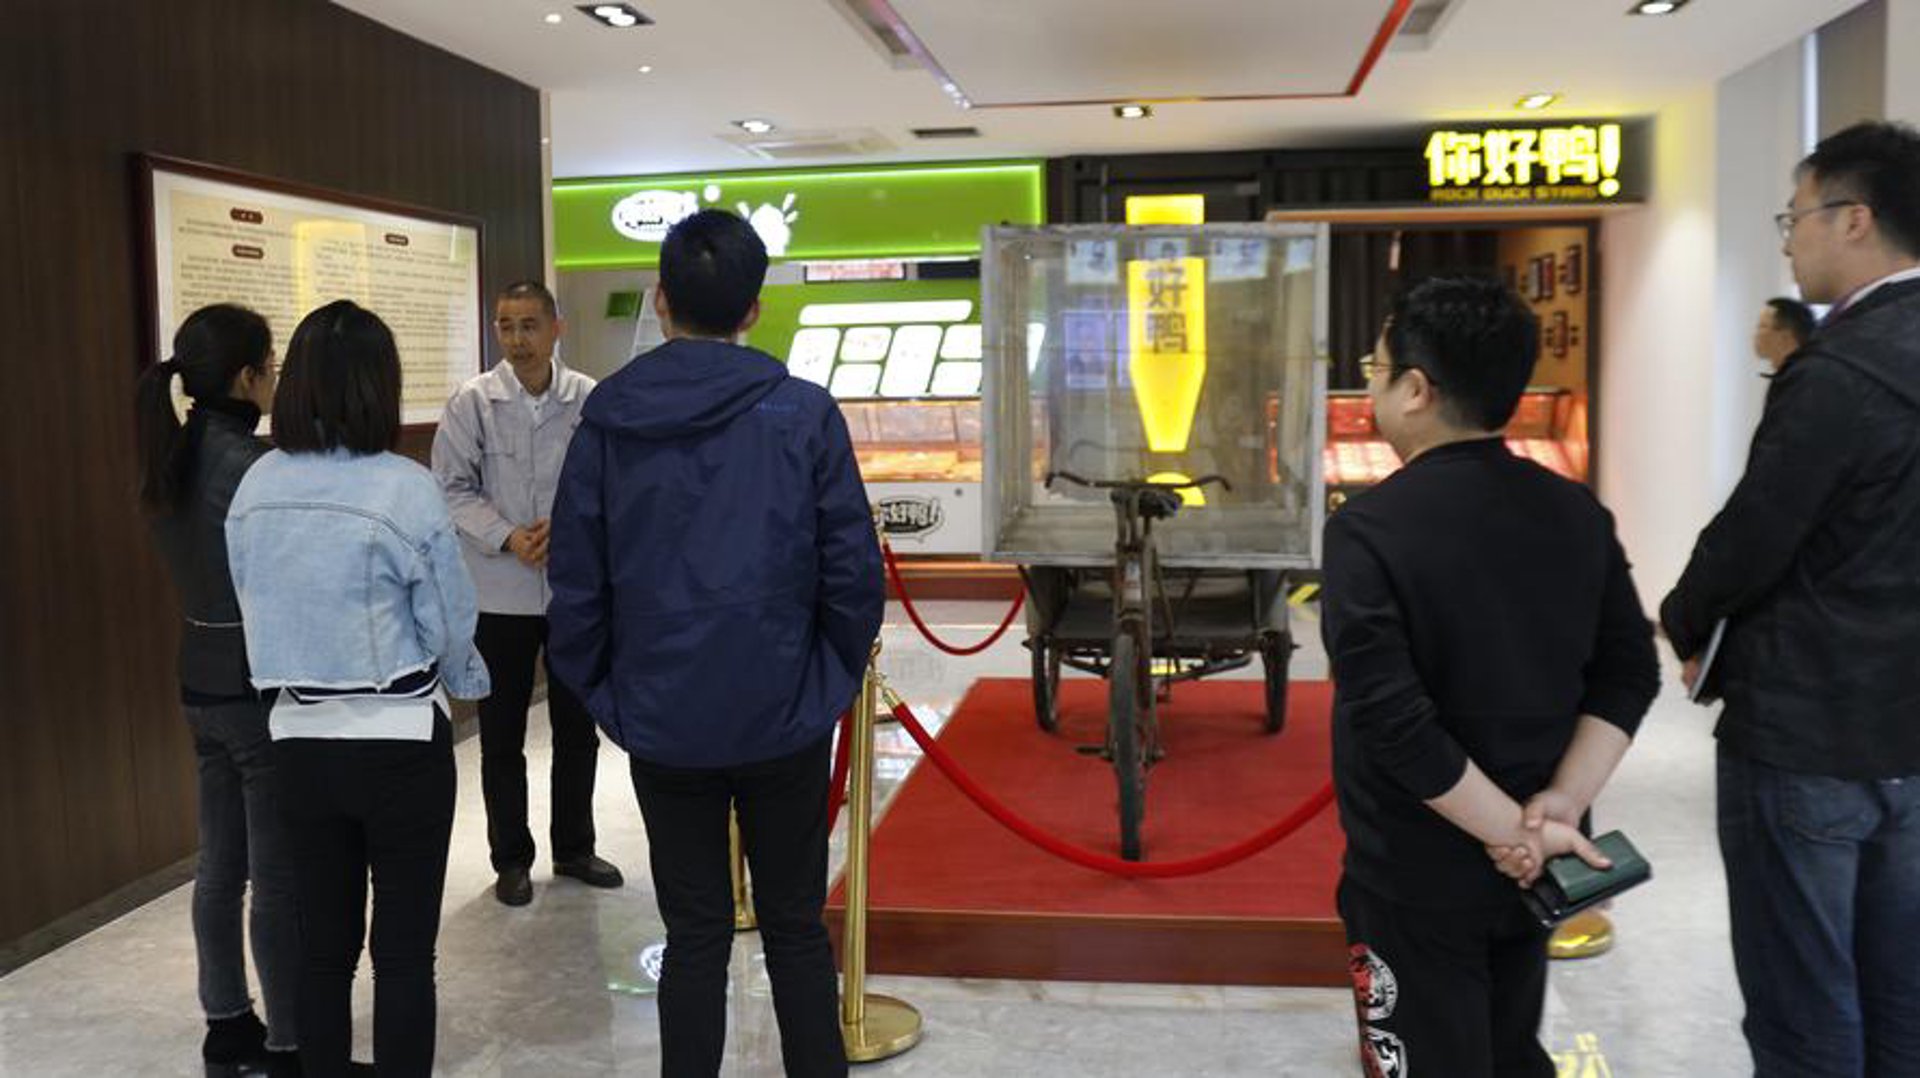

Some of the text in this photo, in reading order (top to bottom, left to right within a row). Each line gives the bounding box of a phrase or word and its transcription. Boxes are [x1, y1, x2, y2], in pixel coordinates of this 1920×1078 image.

[1424, 124, 1621, 197] 你好鸭!
[1481, 185, 1532, 200] DUCK
